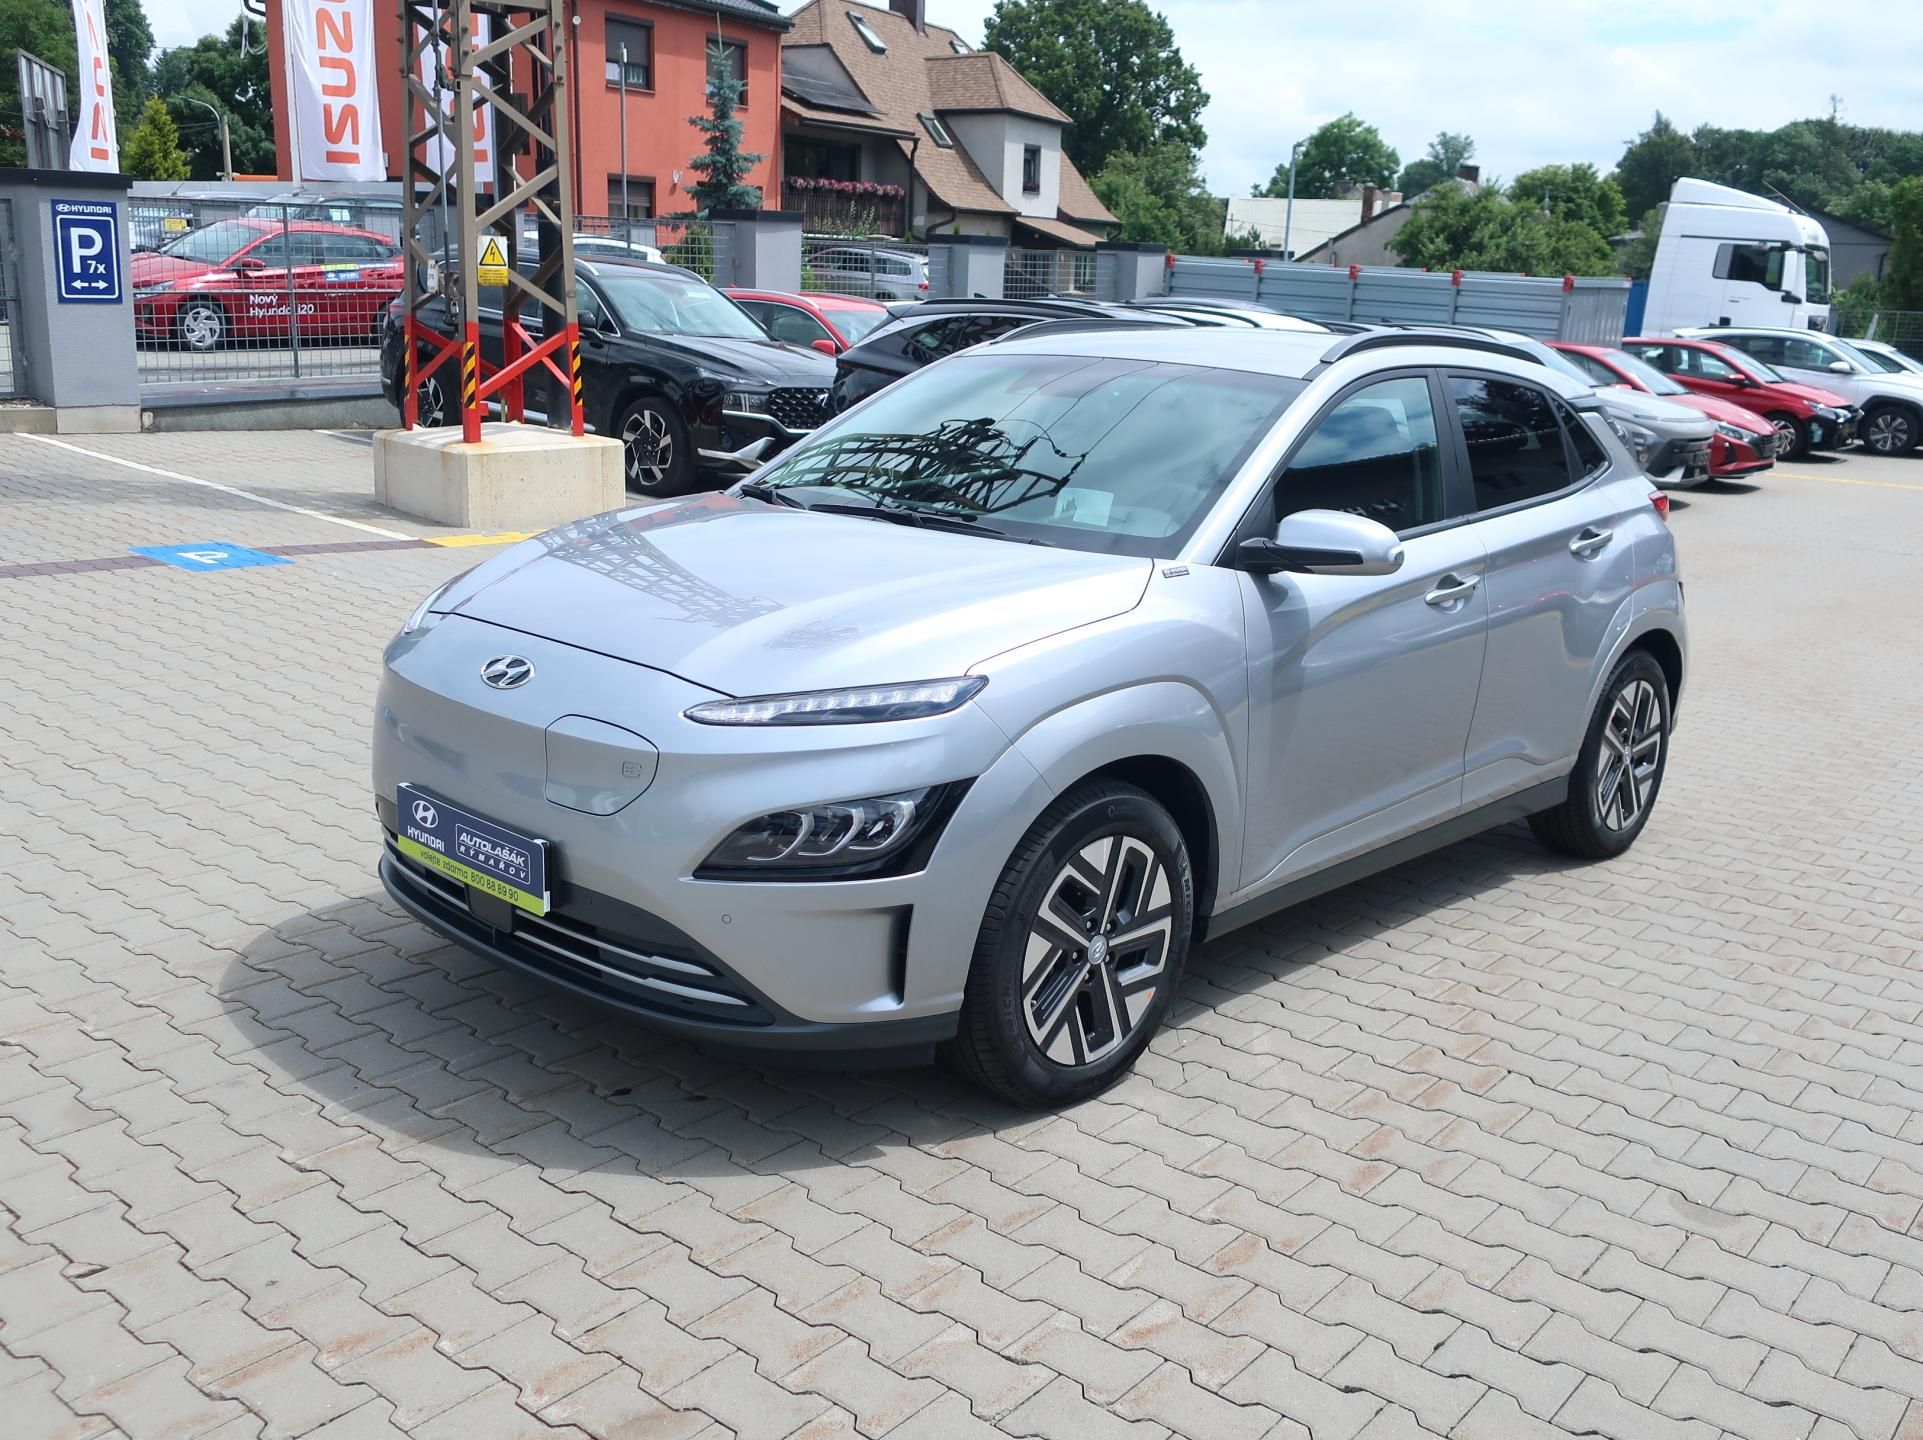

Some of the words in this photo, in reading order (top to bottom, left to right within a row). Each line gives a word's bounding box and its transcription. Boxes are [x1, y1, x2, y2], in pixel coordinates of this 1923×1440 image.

[315, 0, 361, 164] ISUZ
[71, 205, 112, 214] HYUNDAI
[70, 227, 103, 274] P
[87, 260, 107, 274] 7x
[249, 293, 278, 306] Nový
[249, 305, 294, 319] Hyunda
[297, 303, 315, 315] i20
[407, 825, 445, 853] HYUNDAI
[459, 832, 526, 867] AUTOLAŠÁK
[419, 849, 441, 866] volejte
[442, 860, 468, 879] zdarma
[470, 871, 486, 887] 800
[486, 879, 496, 892] 88
[497, 883, 507, 896] 89
[508, 888, 519, 902] 90
